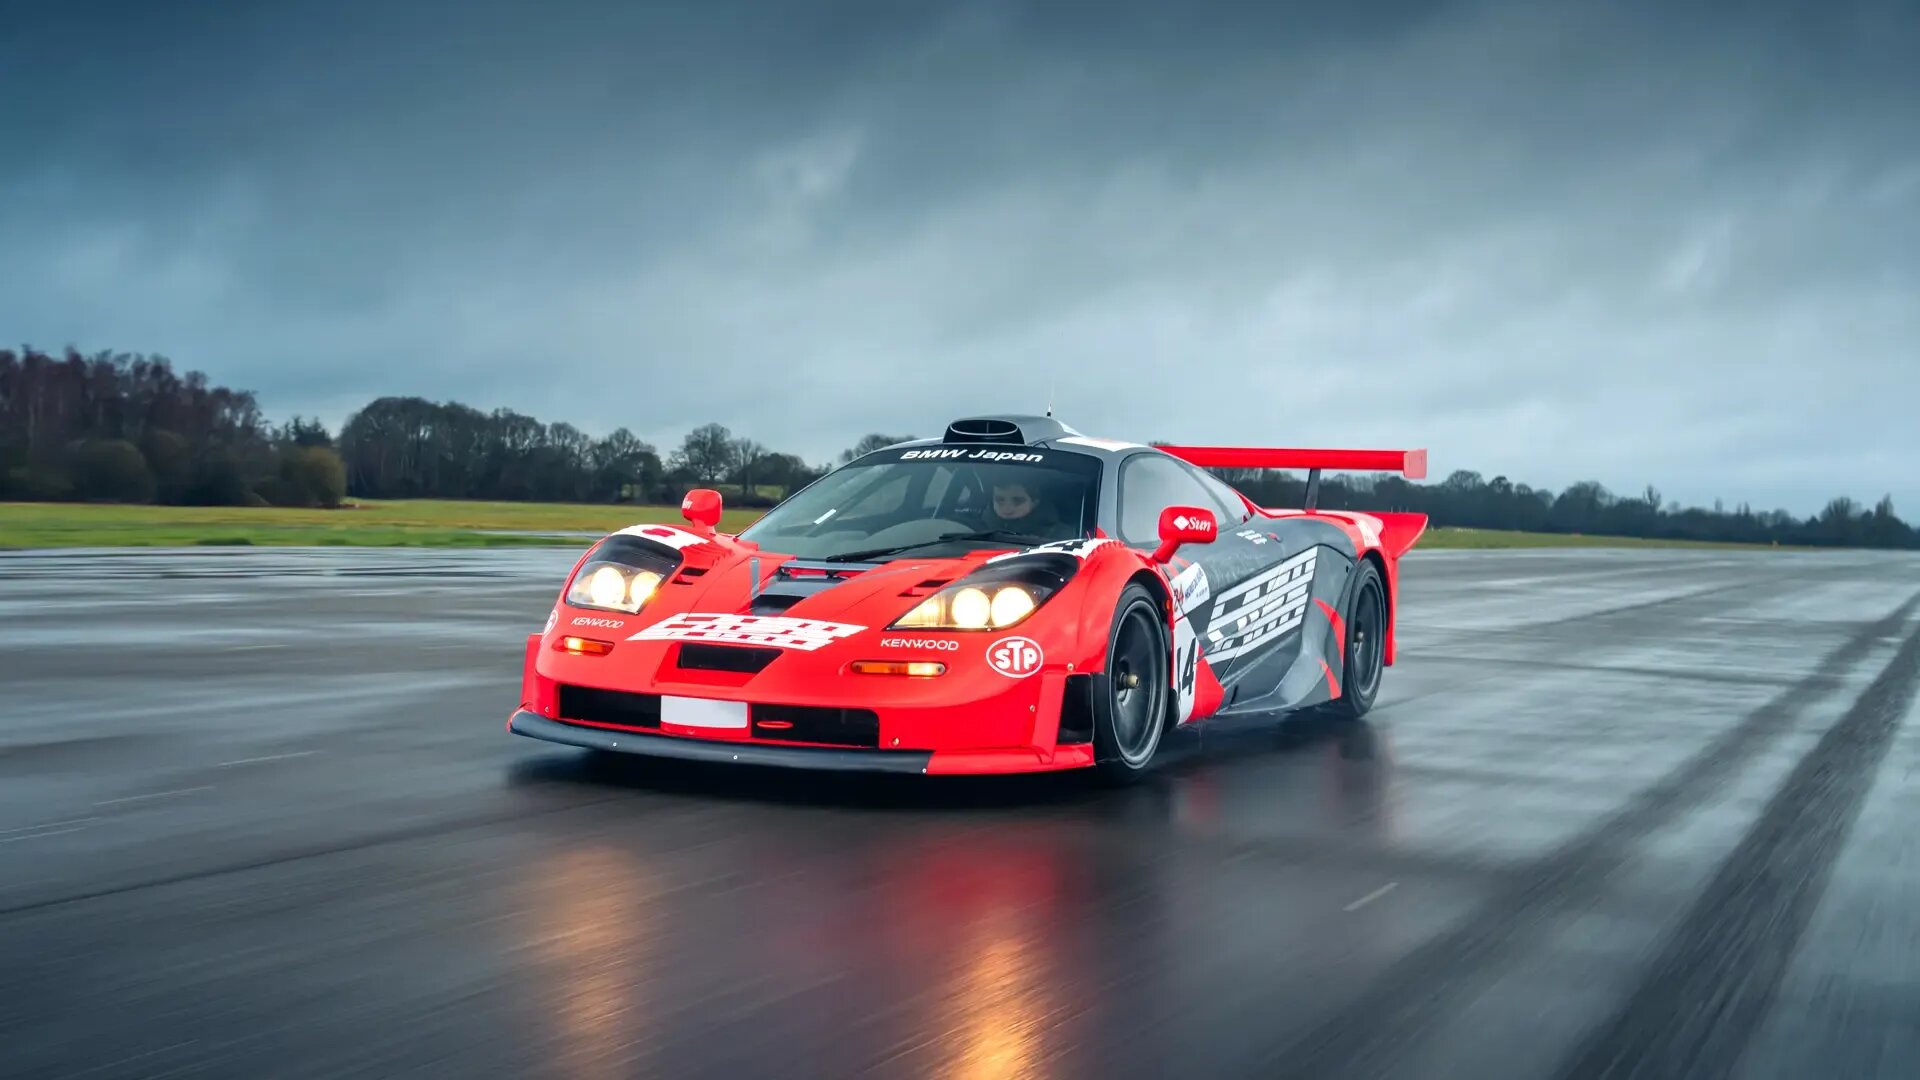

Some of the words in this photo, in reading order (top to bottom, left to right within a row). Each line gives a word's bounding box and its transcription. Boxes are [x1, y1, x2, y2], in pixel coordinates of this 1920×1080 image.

[900, 449, 968, 460] BMW
[968, 450, 1044, 462] Japan
[1188, 516, 1211, 532] Sun
[571, 617, 624, 628] KENWOOD
[881, 638, 959, 651] KENWOOD
[994, 640, 1038, 671] STP
